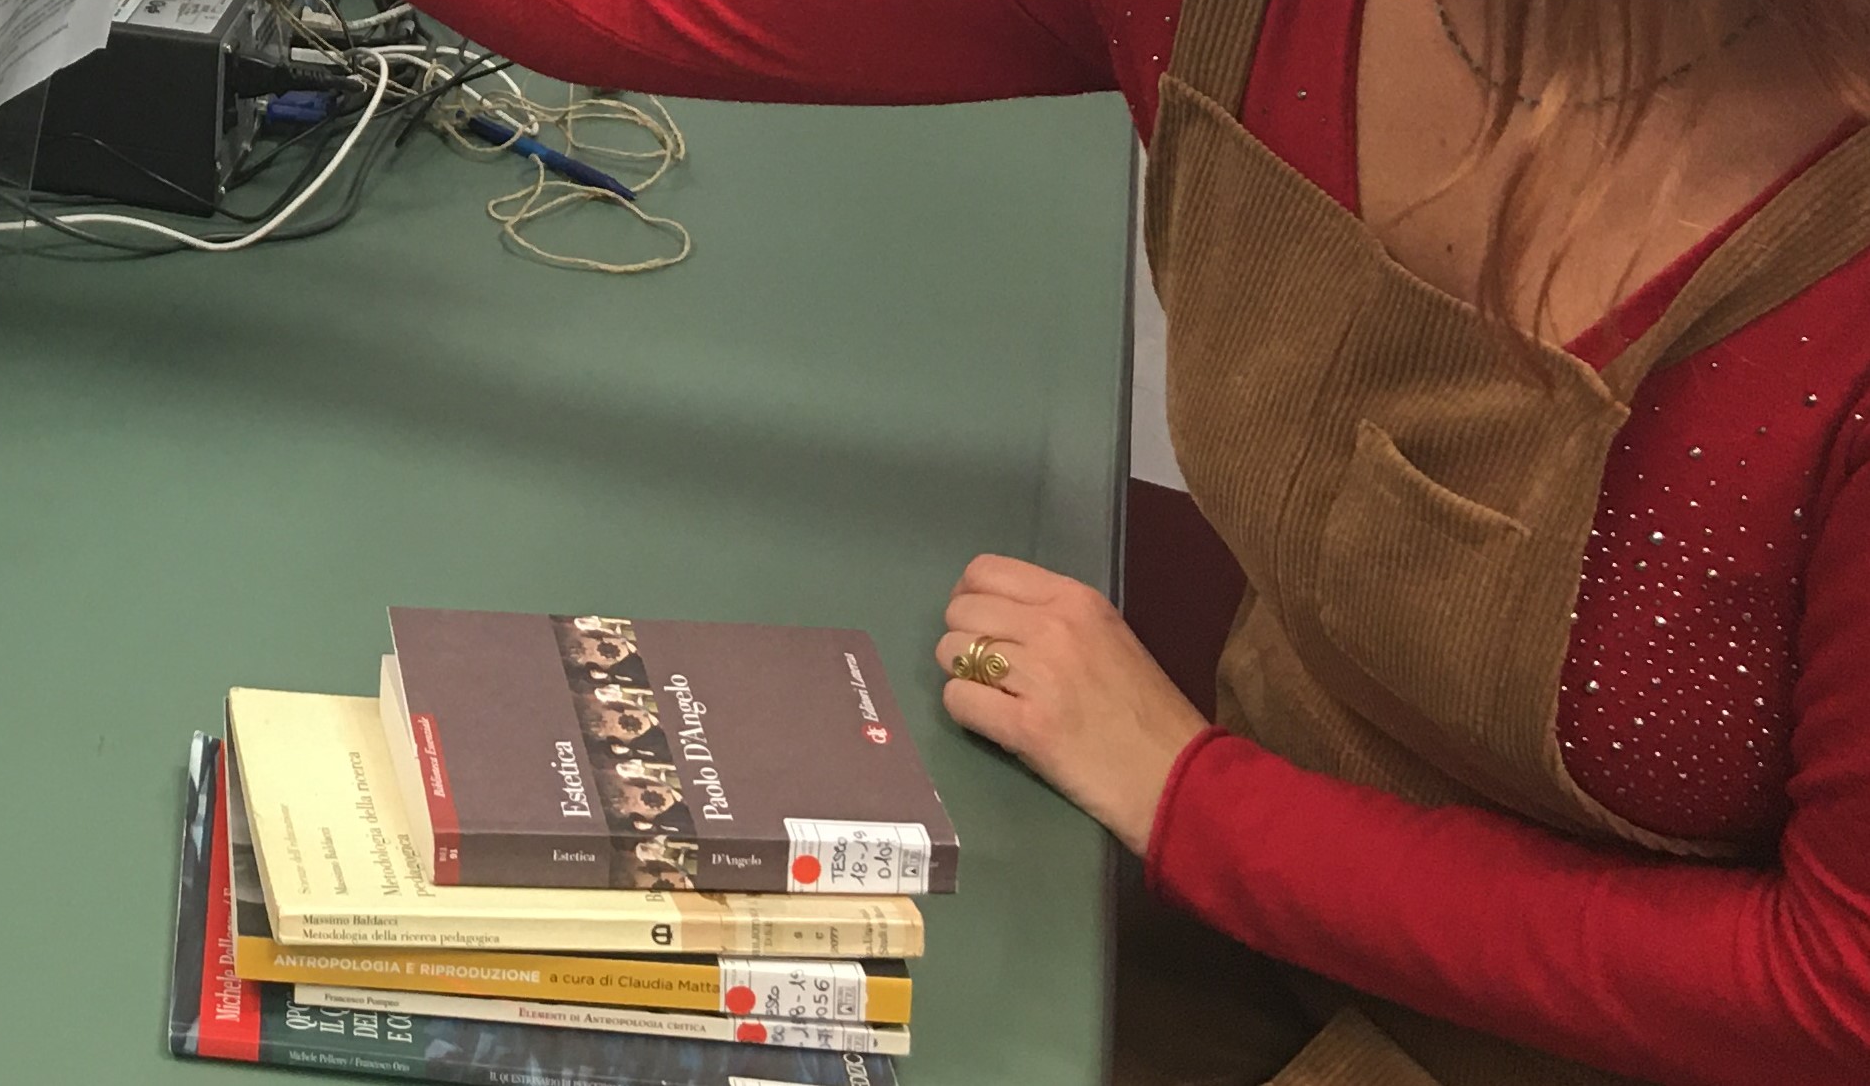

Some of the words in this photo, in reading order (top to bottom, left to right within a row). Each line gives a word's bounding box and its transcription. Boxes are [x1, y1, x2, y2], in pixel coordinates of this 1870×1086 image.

[663, 674, 714, 763] D'Angelo
[859, 688, 879, 722] Editori
[349, 750, 371, 793] ricerca
[550, 740, 593, 820] Estetica
[694, 767, 734, 822] Paolo
[358, 797, 380, 825] della
[368, 828, 403, 897] Metodologia
[552, 848, 596, 863] Estetica
[711, 853, 762, 868] D'Angelo
[302, 914, 350, 926] Massimo
[352, 914, 399, 927] Baldacci
[302, 928, 369, 944] Metodologia
[371, 929, 398, 942] della
[400, 930, 437, 943] ricerca
[439, 932, 500, 946] pedagogica
[274, 953, 401, 975] ANTROPOLOGIA
[406, 963, 415, 975] E
[419, 963, 541, 984] RIPRODUZIONE
[549, 973, 558, 983] a
[562, 973, 595, 987] cura
[599, 973, 614, 987] di
[617, 974, 673, 992] Claudia
[324, 993, 365, 1007] Francesco
[519, 1006, 567, 1022] ELEMENTI
[583, 1012, 664, 1029] ANTROPOLOGIA
[666, 1019, 707, 1033] CRITICA
